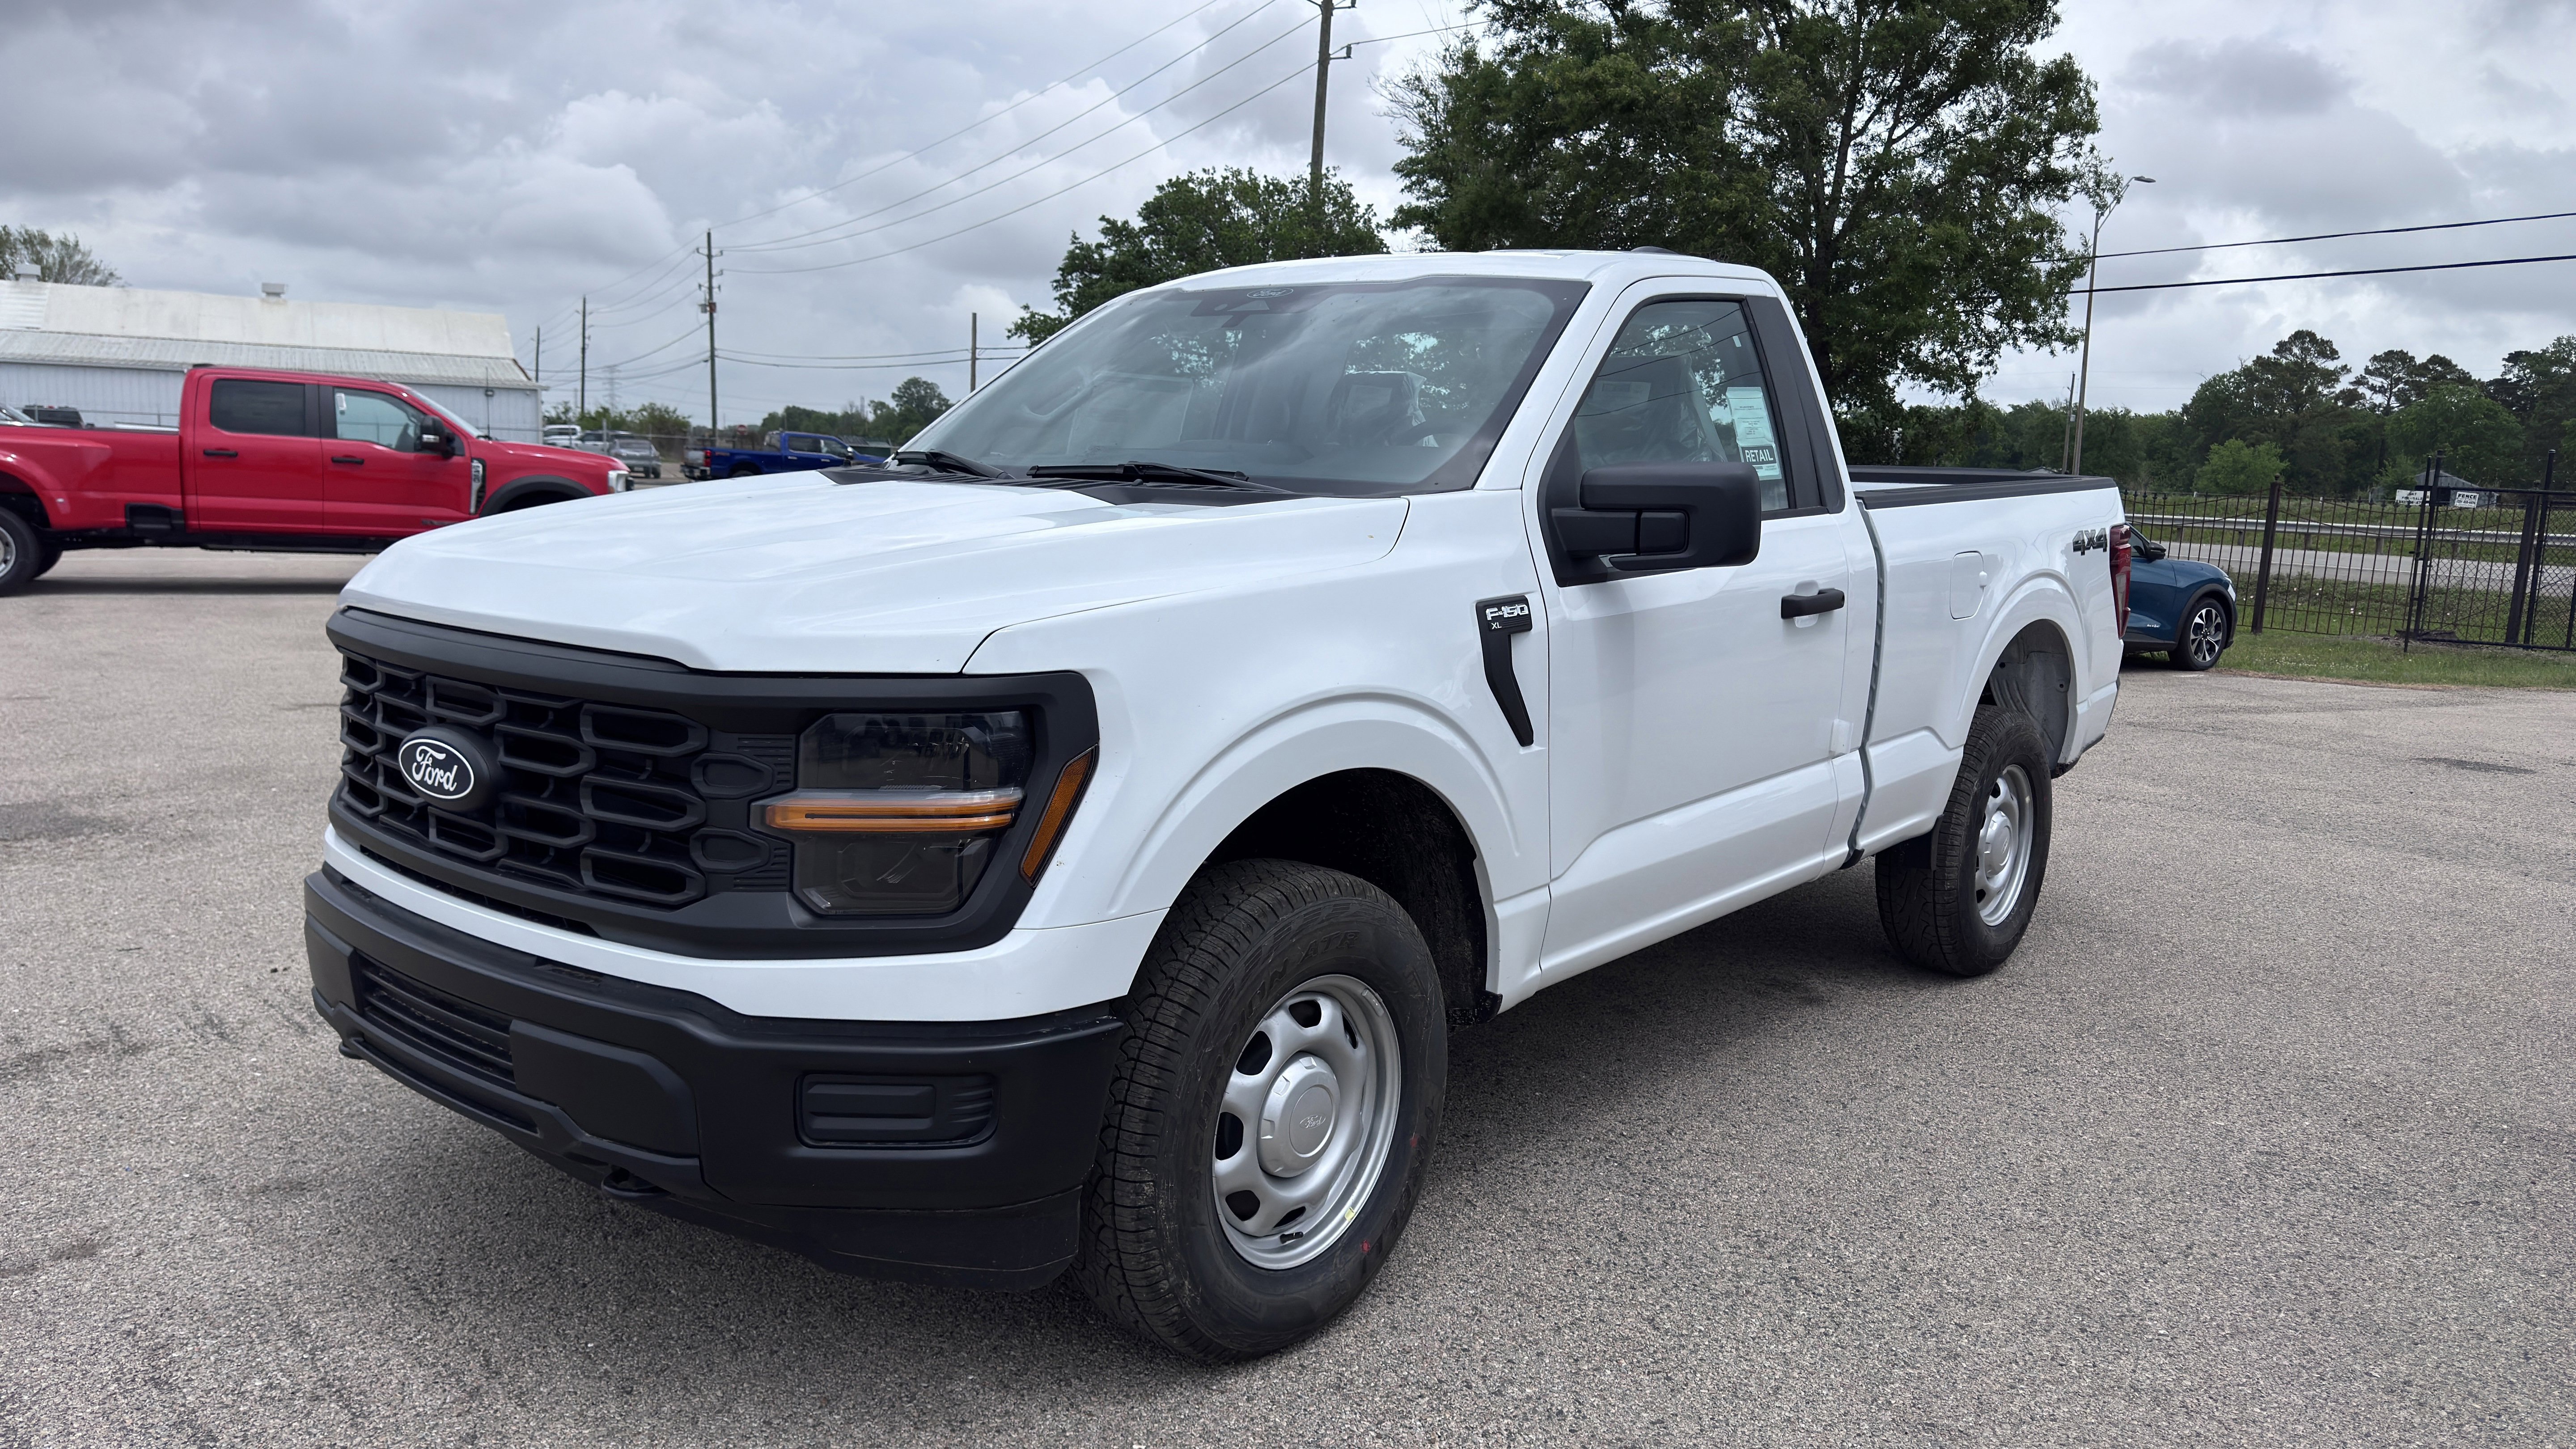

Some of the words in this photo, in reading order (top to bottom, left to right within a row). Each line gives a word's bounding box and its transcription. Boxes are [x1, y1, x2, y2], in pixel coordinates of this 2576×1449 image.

[1745, 449, 1774, 462] RETAIL
[1486, 604, 1529, 620] F-150
[412, 746, 458, 792] Ford
[1298, 930, 1361, 965] ATR
[1305, 1115, 1322, 1128] Ford
